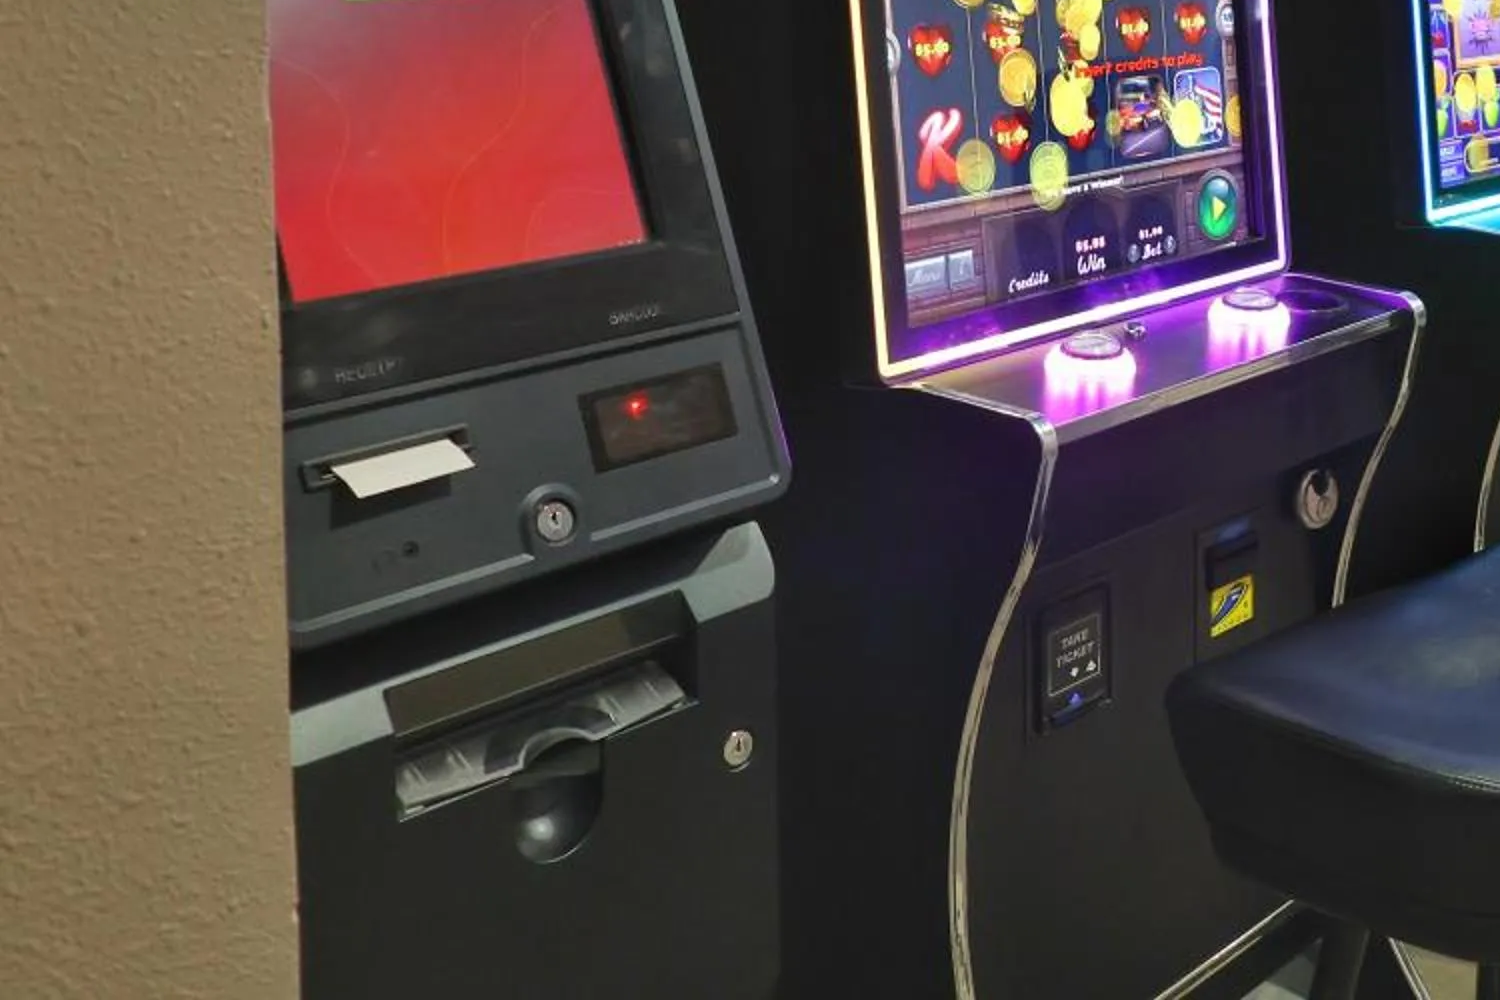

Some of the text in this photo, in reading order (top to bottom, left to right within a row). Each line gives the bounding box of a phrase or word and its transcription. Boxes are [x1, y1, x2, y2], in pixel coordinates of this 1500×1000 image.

[1115, 56, 1158, 72] credits
[1141, 243, 1163, 261] Bet
[1077, 255, 1107, 275] Win
[1008, 271, 1049, 294] Credits
[1061, 629, 1089, 650] TAKE
[1056, 641, 1095, 668] TICKET
